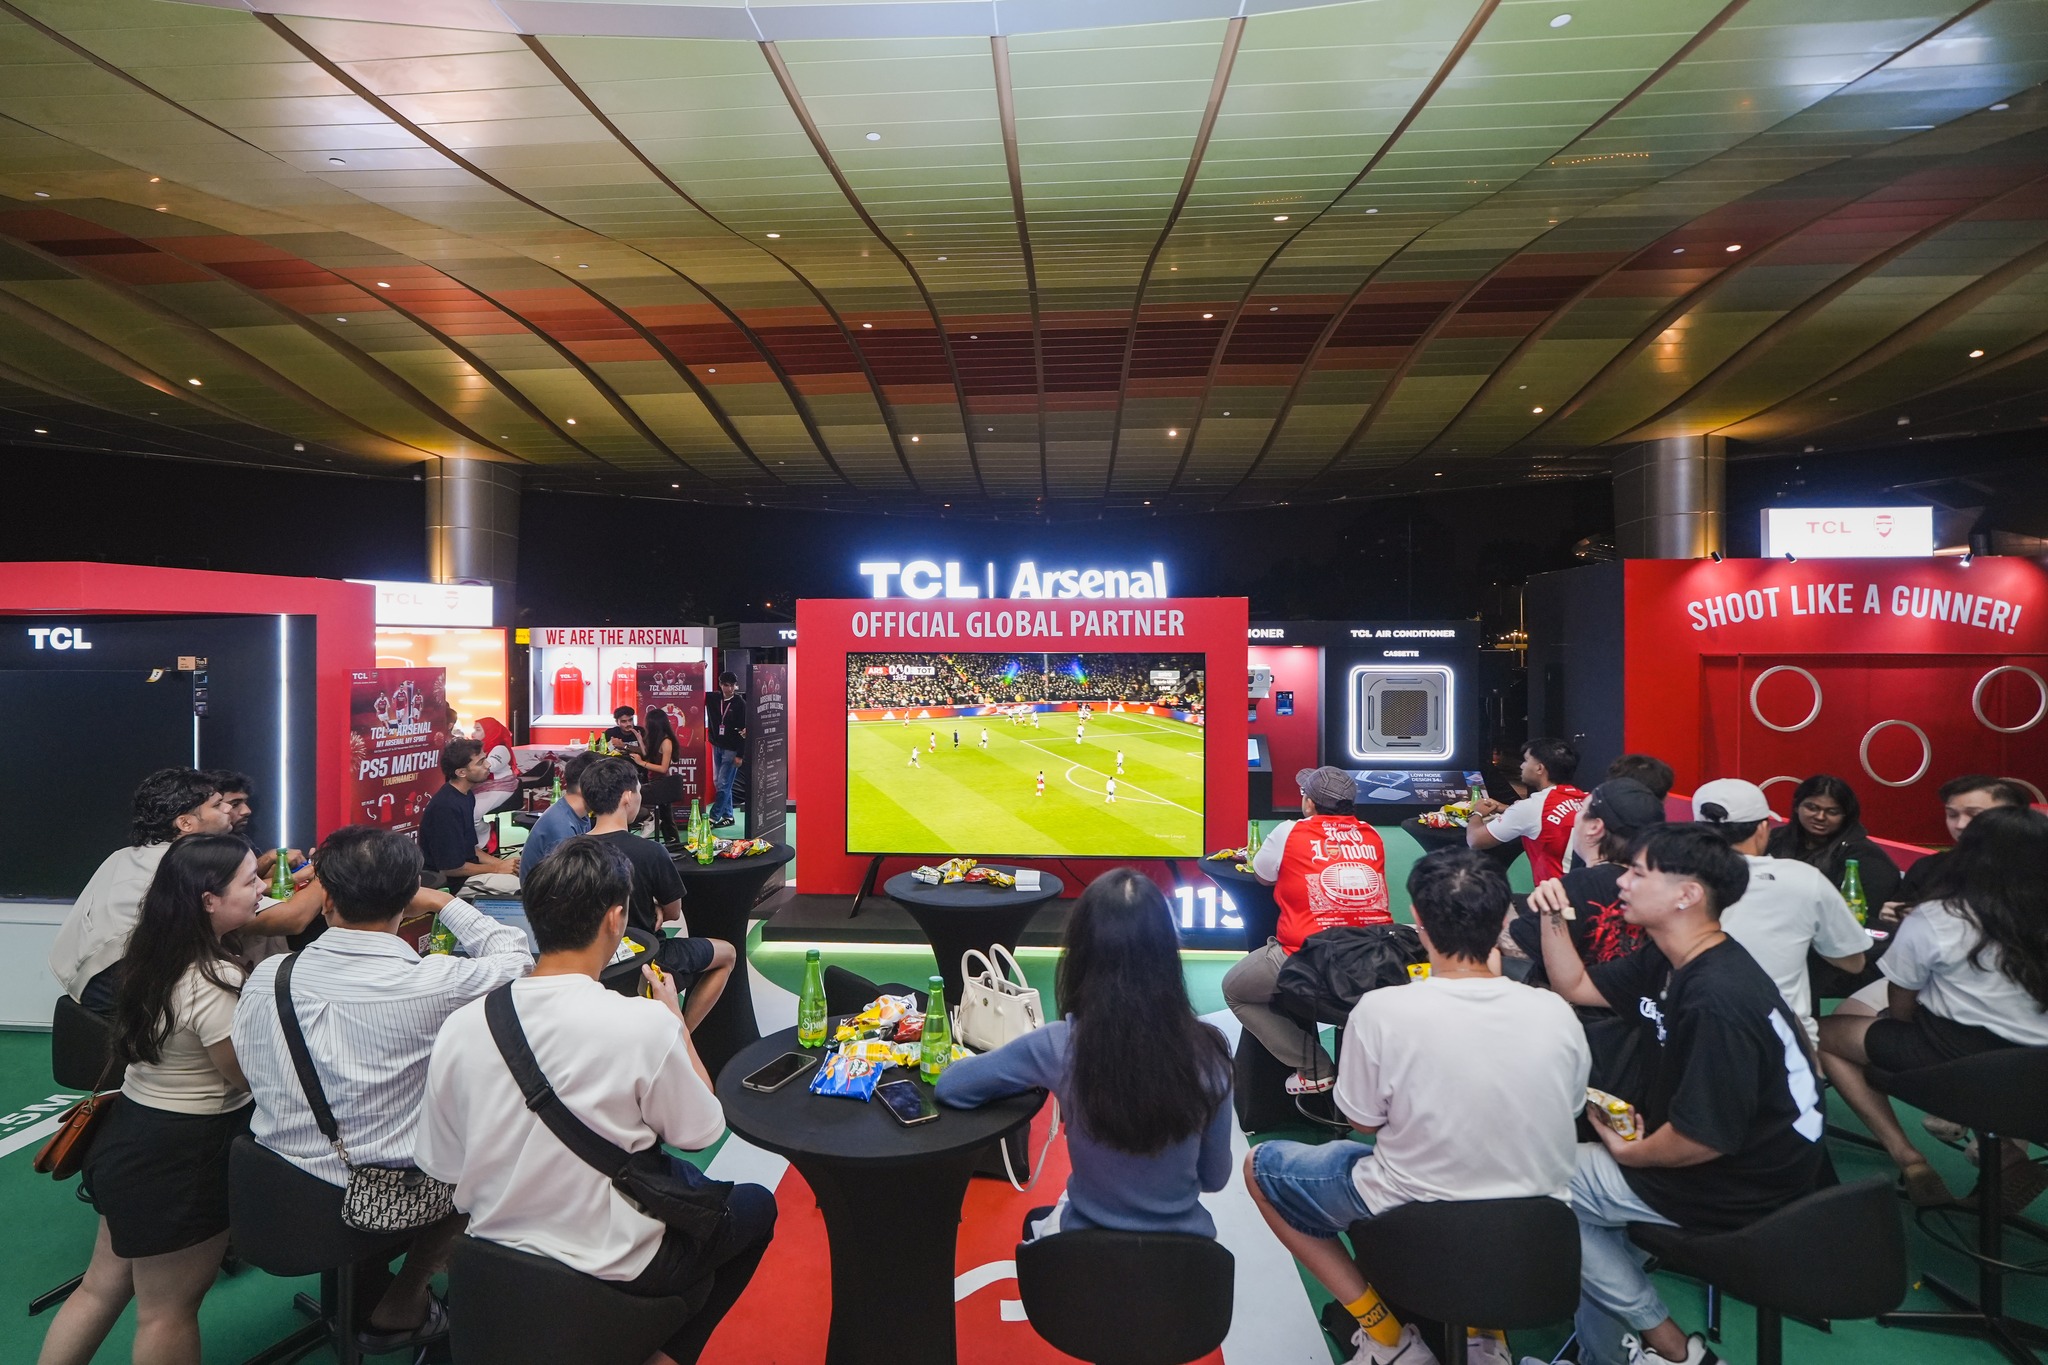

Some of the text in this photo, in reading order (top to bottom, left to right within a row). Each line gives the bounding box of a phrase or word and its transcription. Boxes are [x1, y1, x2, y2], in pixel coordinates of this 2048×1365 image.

[1805, 521, 1852, 533] TCL
[860, 561, 1167, 598] TCL Arsenal
[382, 592, 423, 605] TCL
[1687, 583, 2022, 635] SHOOT LIKE A GUNNER!
[851, 609, 1185, 638] OFFICIAL GLOBAL PARTNER
[28, 627, 92, 650] TCL
[546, 629, 689, 645] WE ARE THE ARSENAL
[778, 630, 797, 640] TC
[1247, 629, 1284, 638] IONER
[649, 684, 661, 692] TCL
[665, 684, 693, 692] ARSENAL
[371, 727, 387, 740] TCL
[396, 722, 432, 737] ARSENAL
[376, 740, 385, 748] MY
[385, 738, 405, 747] ARSENAL
[413, 735, 427, 743] SPIRIT
[359, 750, 439, 781] PS5 MATCH!
[382, 773, 419, 787] TOURNAMENT
[1323, 827, 1363, 844] North
[1309, 840, 1378, 864] Lndon
[0, 1094, 86, 1136] .5M
